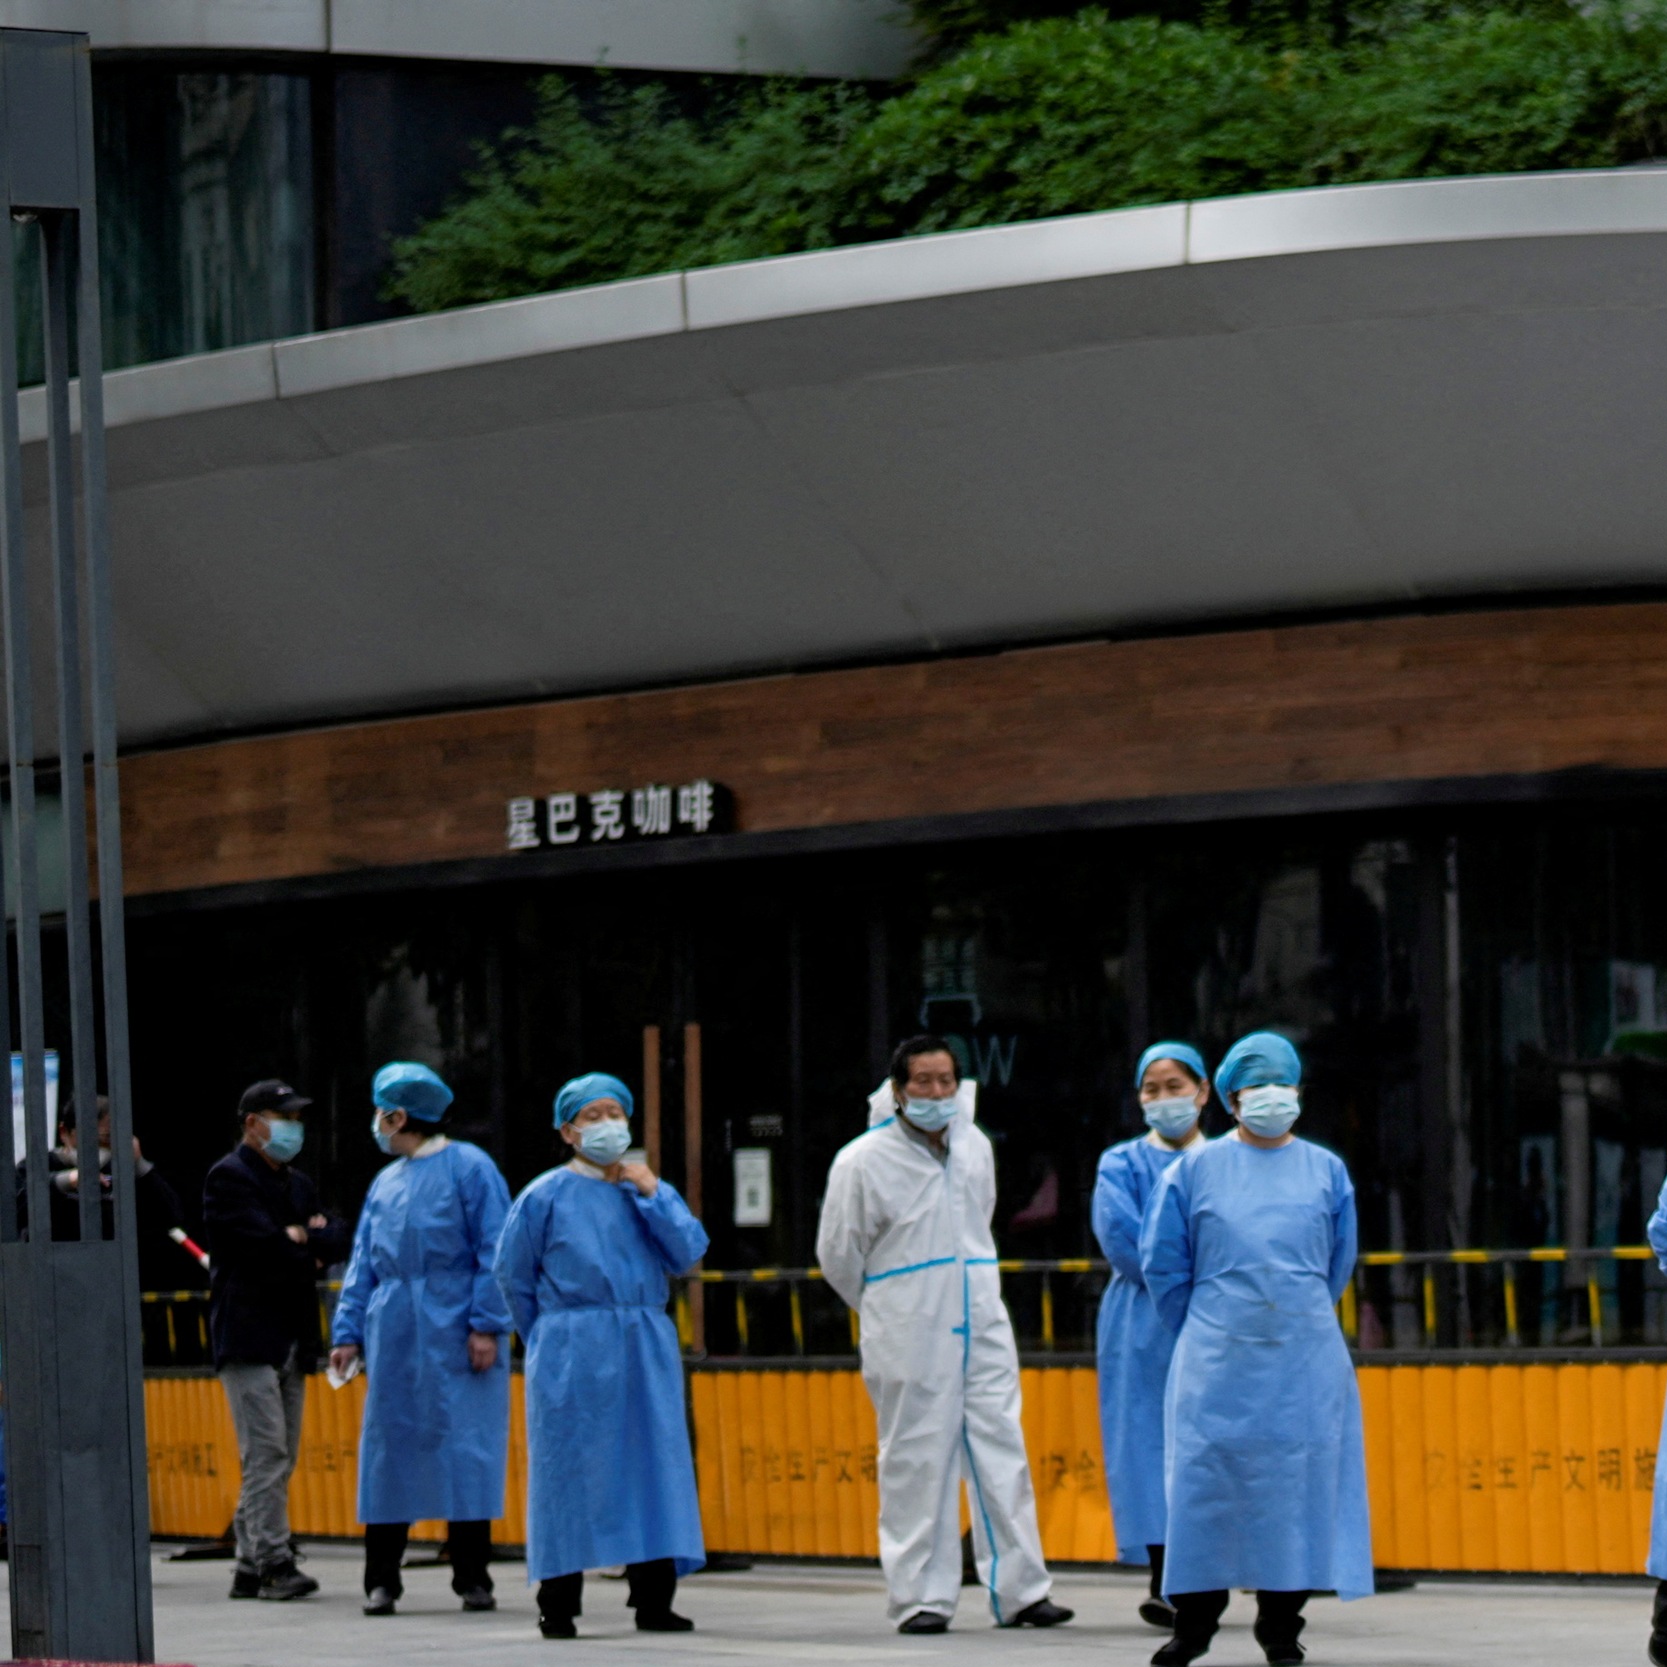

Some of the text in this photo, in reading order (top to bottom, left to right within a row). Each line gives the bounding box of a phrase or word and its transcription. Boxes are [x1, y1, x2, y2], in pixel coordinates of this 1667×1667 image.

[507, 778, 715, 850] 星巴克咖啡
